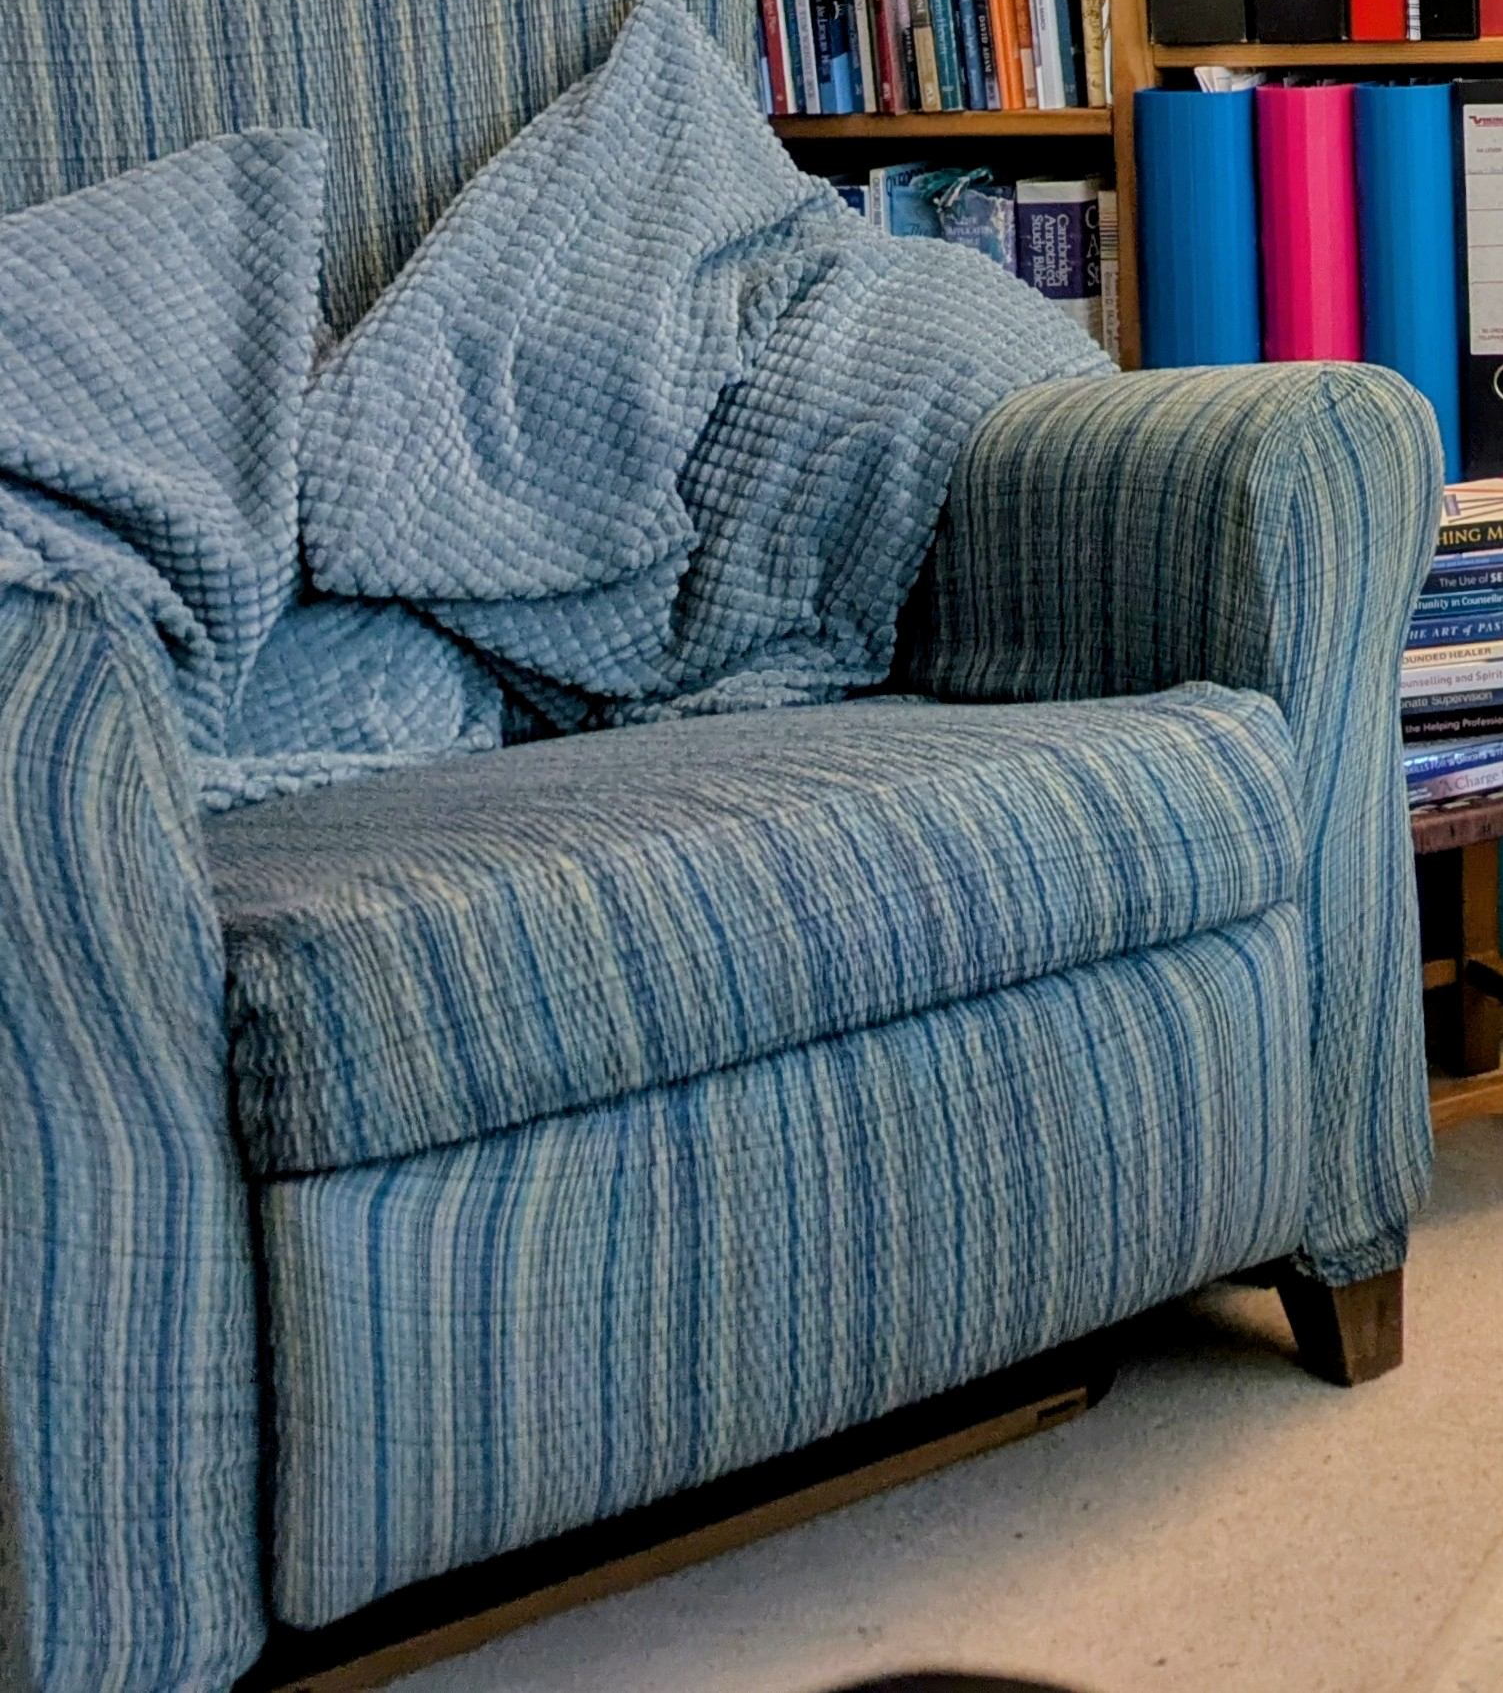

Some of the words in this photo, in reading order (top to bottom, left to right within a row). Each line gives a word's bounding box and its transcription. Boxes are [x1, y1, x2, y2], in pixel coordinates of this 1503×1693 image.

[1028, 214, 1045, 253] Study
[1044, 214, 1062, 287] Annotated
[1055, 213, 1072, 287] Cambridge
[1432, 625, 1457, 638] ART
[1450, 647, 1492, 659] HEALER
[1455, 672, 1473, 683] and
[1430, 691, 1493, 707] Supervision
[1423, 719, 1460, 733] Helping
[1455, 772, 1500, 791] Charge
